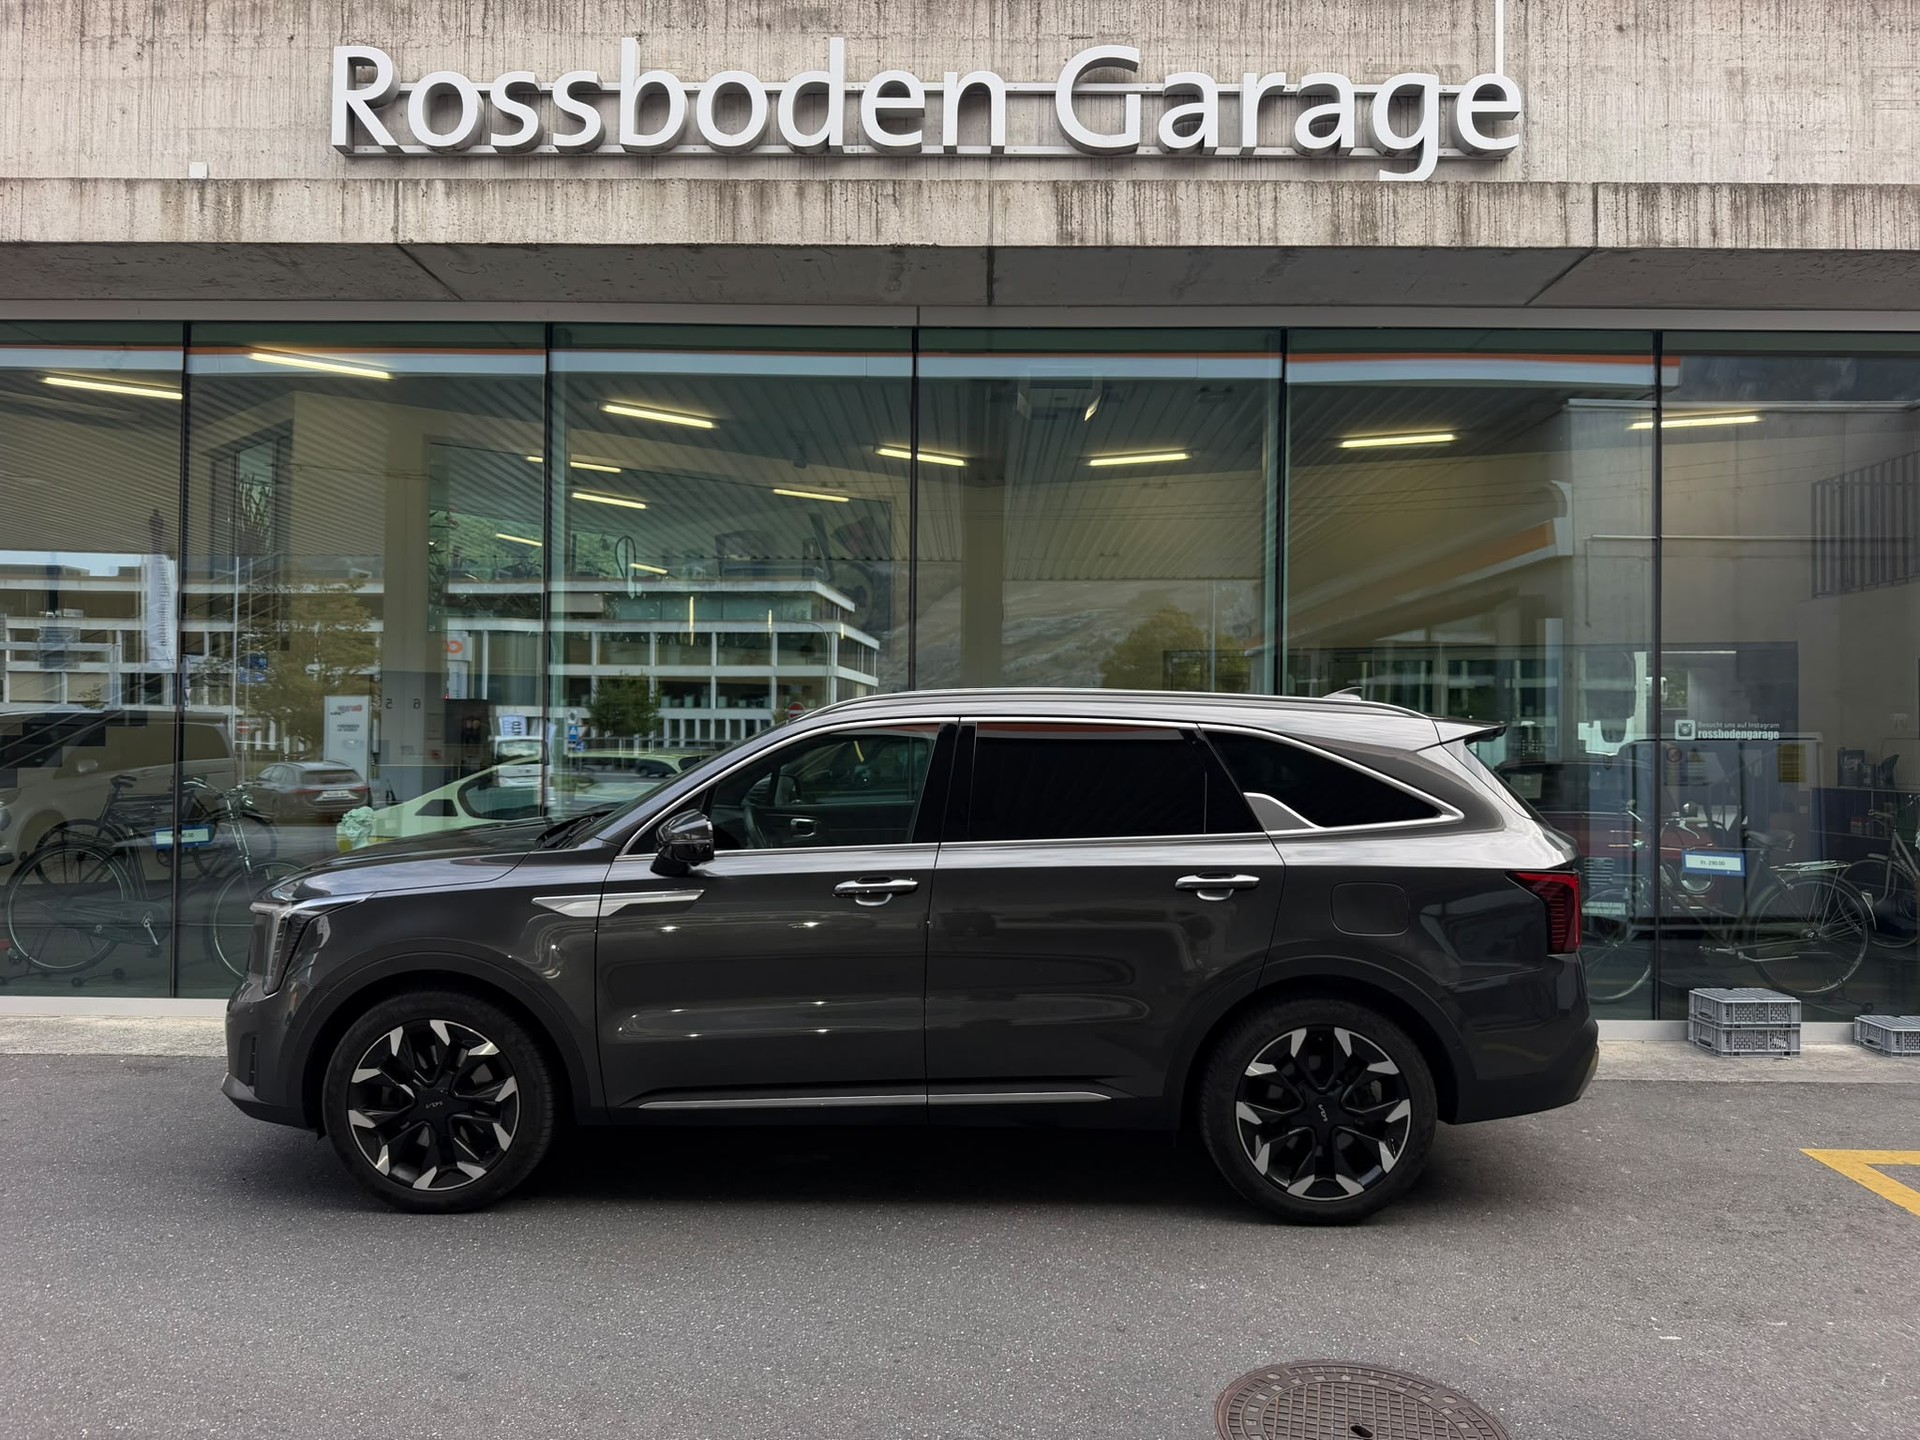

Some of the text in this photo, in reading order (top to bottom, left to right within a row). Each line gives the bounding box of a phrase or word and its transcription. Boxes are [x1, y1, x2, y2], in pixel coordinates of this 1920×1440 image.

[331, 37, 1523, 182] Rossboden Garage
[1697, 721, 1723, 729] Besucht
[1747, 721, 1780, 730] Instagram
[1697, 729, 1780, 740] rossbodengarage
